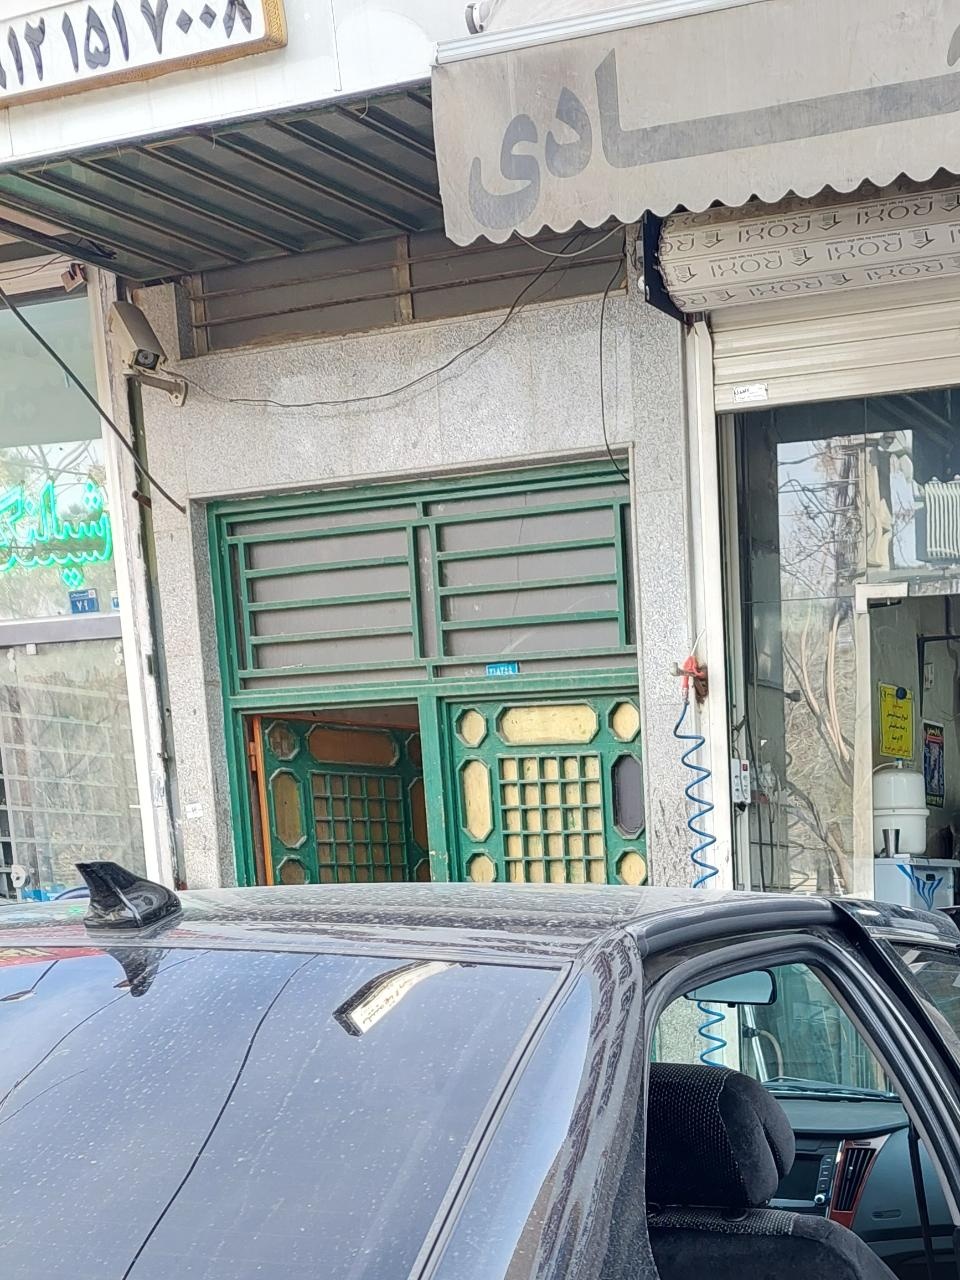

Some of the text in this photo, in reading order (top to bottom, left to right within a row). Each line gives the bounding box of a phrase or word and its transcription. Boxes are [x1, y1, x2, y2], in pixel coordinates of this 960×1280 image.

[856, 201, 933, 225] ROXI
[738, 219, 811, 243] ROXI
[827, 237, 903, 261] ROXI
[711, 255, 783, 278] ROXI
[866, 262, 944, 281] ROXI
[749, 278, 823, 297] ROXI
